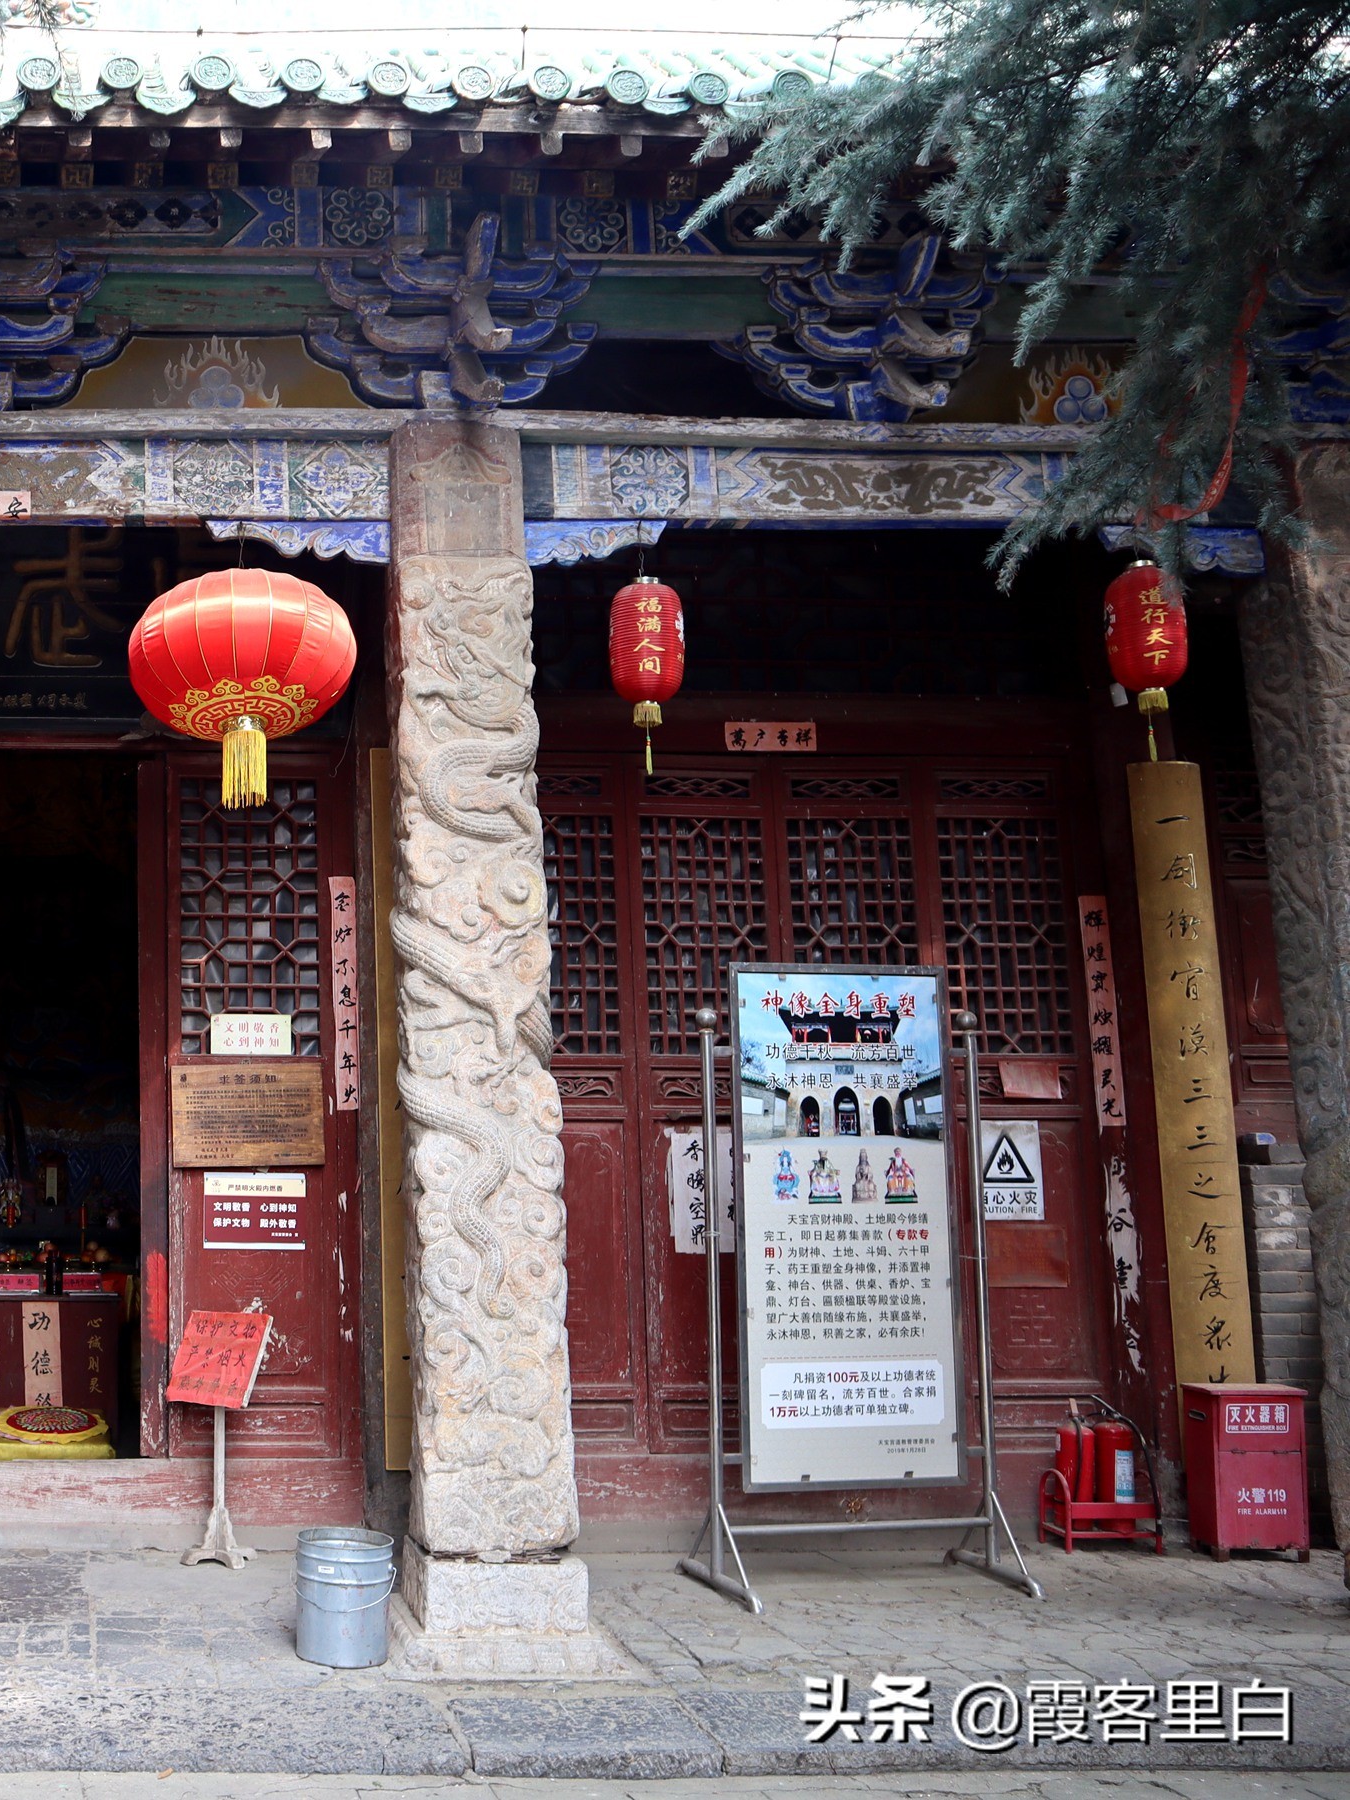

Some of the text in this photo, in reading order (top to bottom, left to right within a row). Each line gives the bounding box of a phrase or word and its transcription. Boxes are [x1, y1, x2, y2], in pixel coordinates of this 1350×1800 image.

[1139, 588, 1174, 666] 道行天下
[633, 597, 666, 675] 福满人间
[761, 989, 917, 1019] 神像金身重塑
[224, 1021, 280, 1034] 文明敬香
[223, 1036, 280, 1048] 心到神知
[765, 1043, 916, 1060] 功德千秋 流芳百世
[766, 1072, 918, 1090] 永沐神恩 共襄盛举
[213, 1201, 297, 1213] 文明敬香 心到神知
[1021, 1206, 1038, 1214] FIRE
[213, 1217, 297, 1229] 保护文物 殿外敬香
[787, 1212, 929, 1226] 天宝宫财神殿、土地殿今修缮
[792, 1369, 937, 1385] 凡捐资100元及以上功德者统
[1229, 1405, 1286, 1424] 灭火器箱
